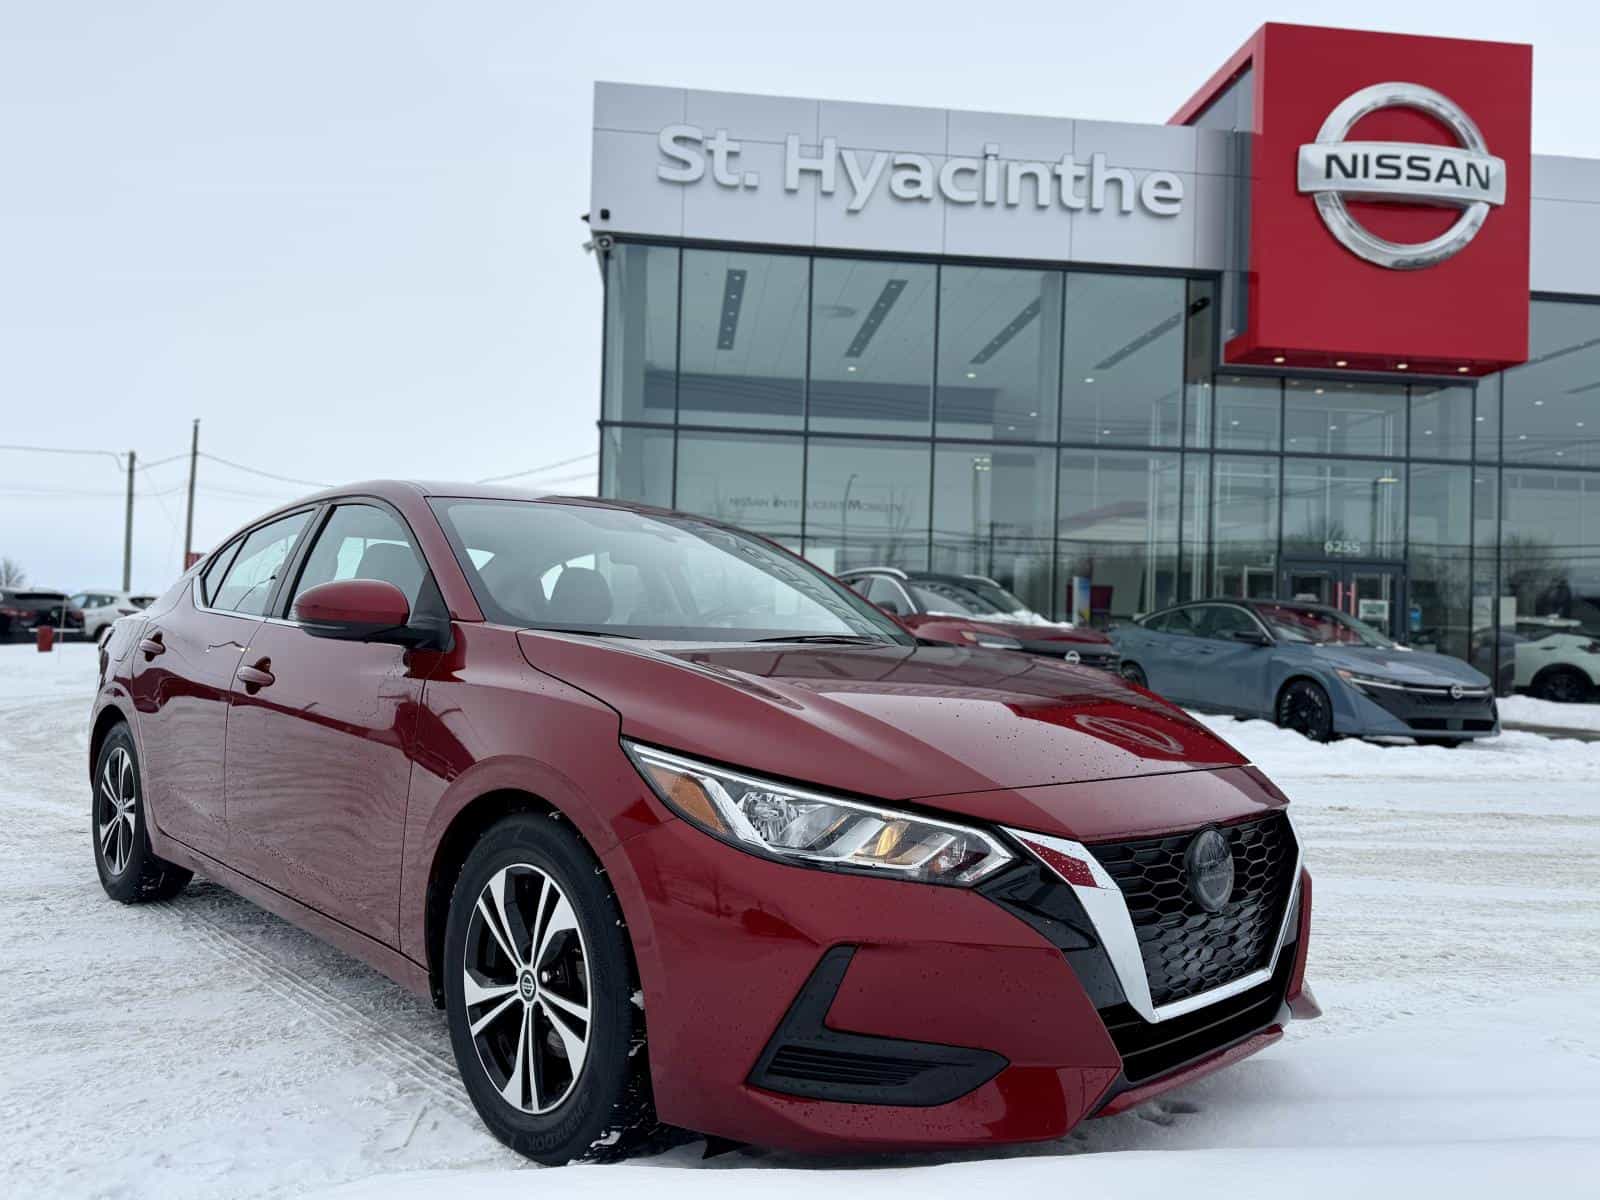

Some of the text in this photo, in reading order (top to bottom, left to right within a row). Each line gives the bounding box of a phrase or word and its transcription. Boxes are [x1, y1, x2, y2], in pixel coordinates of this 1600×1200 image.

[656, 124, 1186, 217] St. Hyacinthe
[1325, 153, 1491, 190] NISSAN
[1324, 540, 1361, 553] 6255
